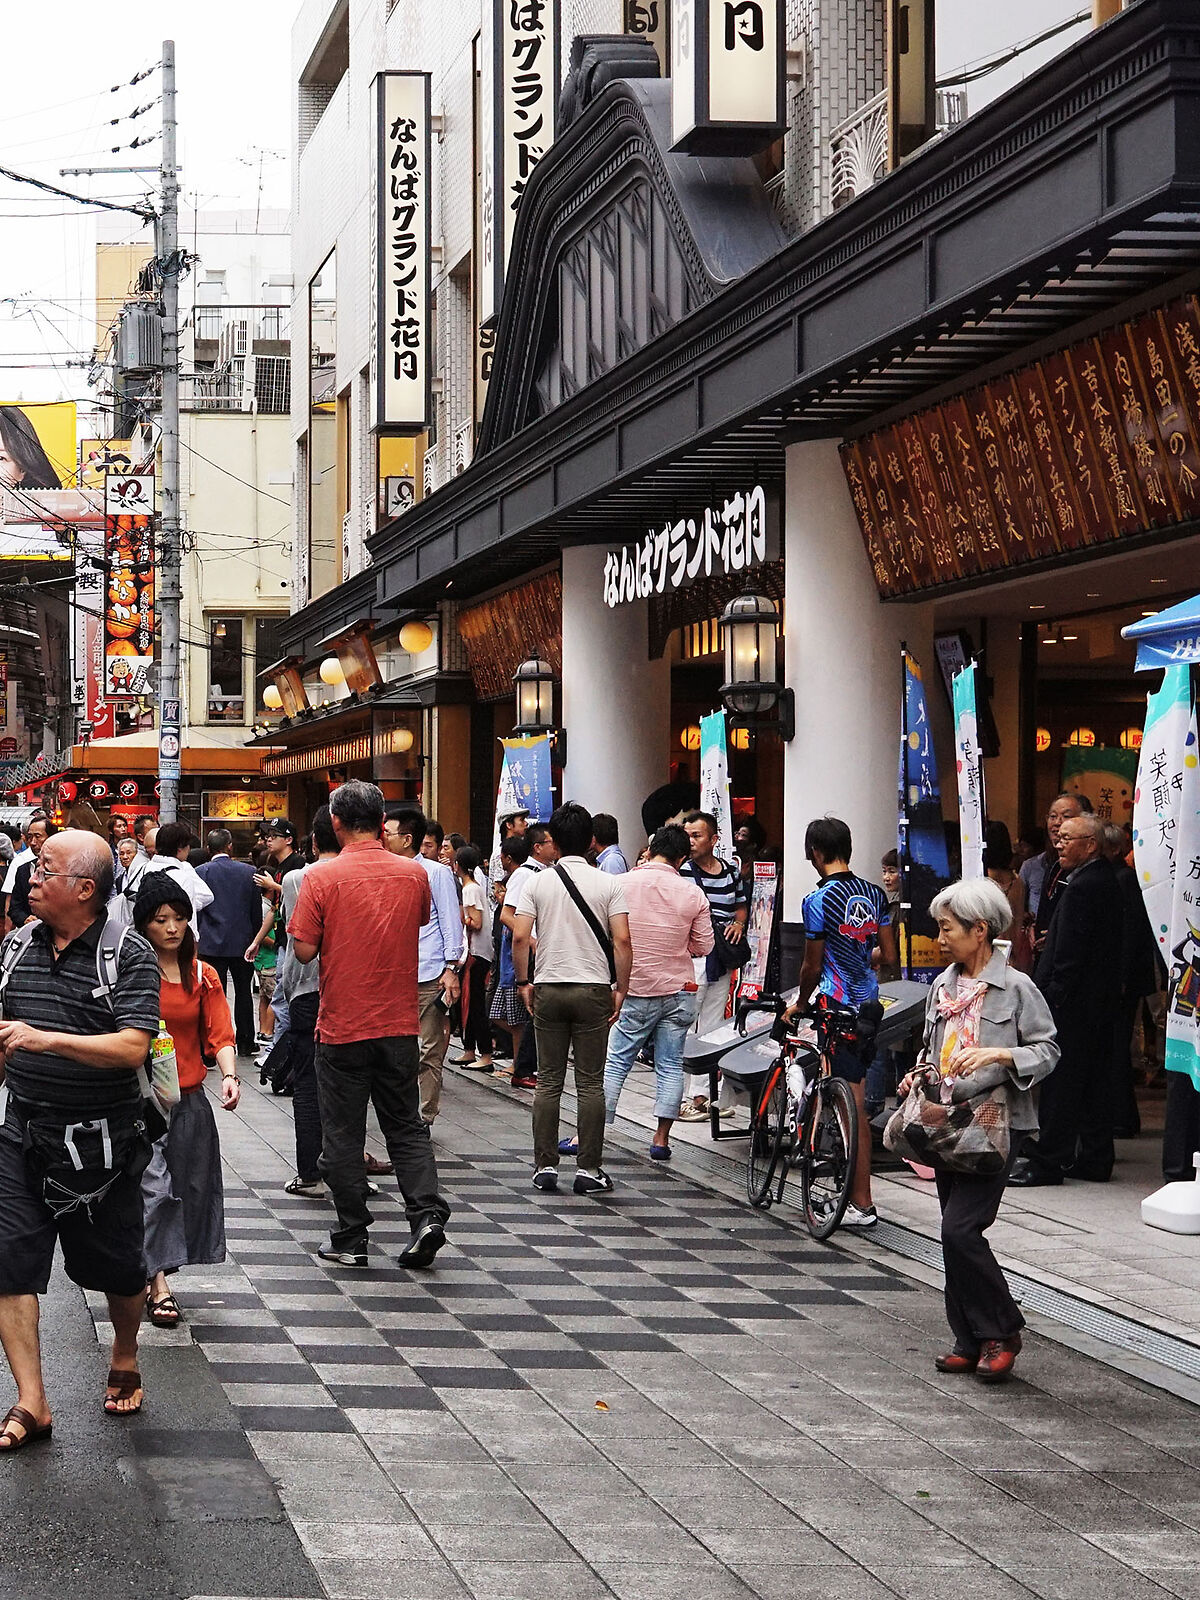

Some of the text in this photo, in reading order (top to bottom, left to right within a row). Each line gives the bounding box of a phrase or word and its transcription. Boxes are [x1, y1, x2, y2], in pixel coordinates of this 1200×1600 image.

[510, 0, 545, 211] ばグランド
[390, 117, 421, 380] なんばグランド花月
[603, 485, 766, 608] なんばグランド花月
